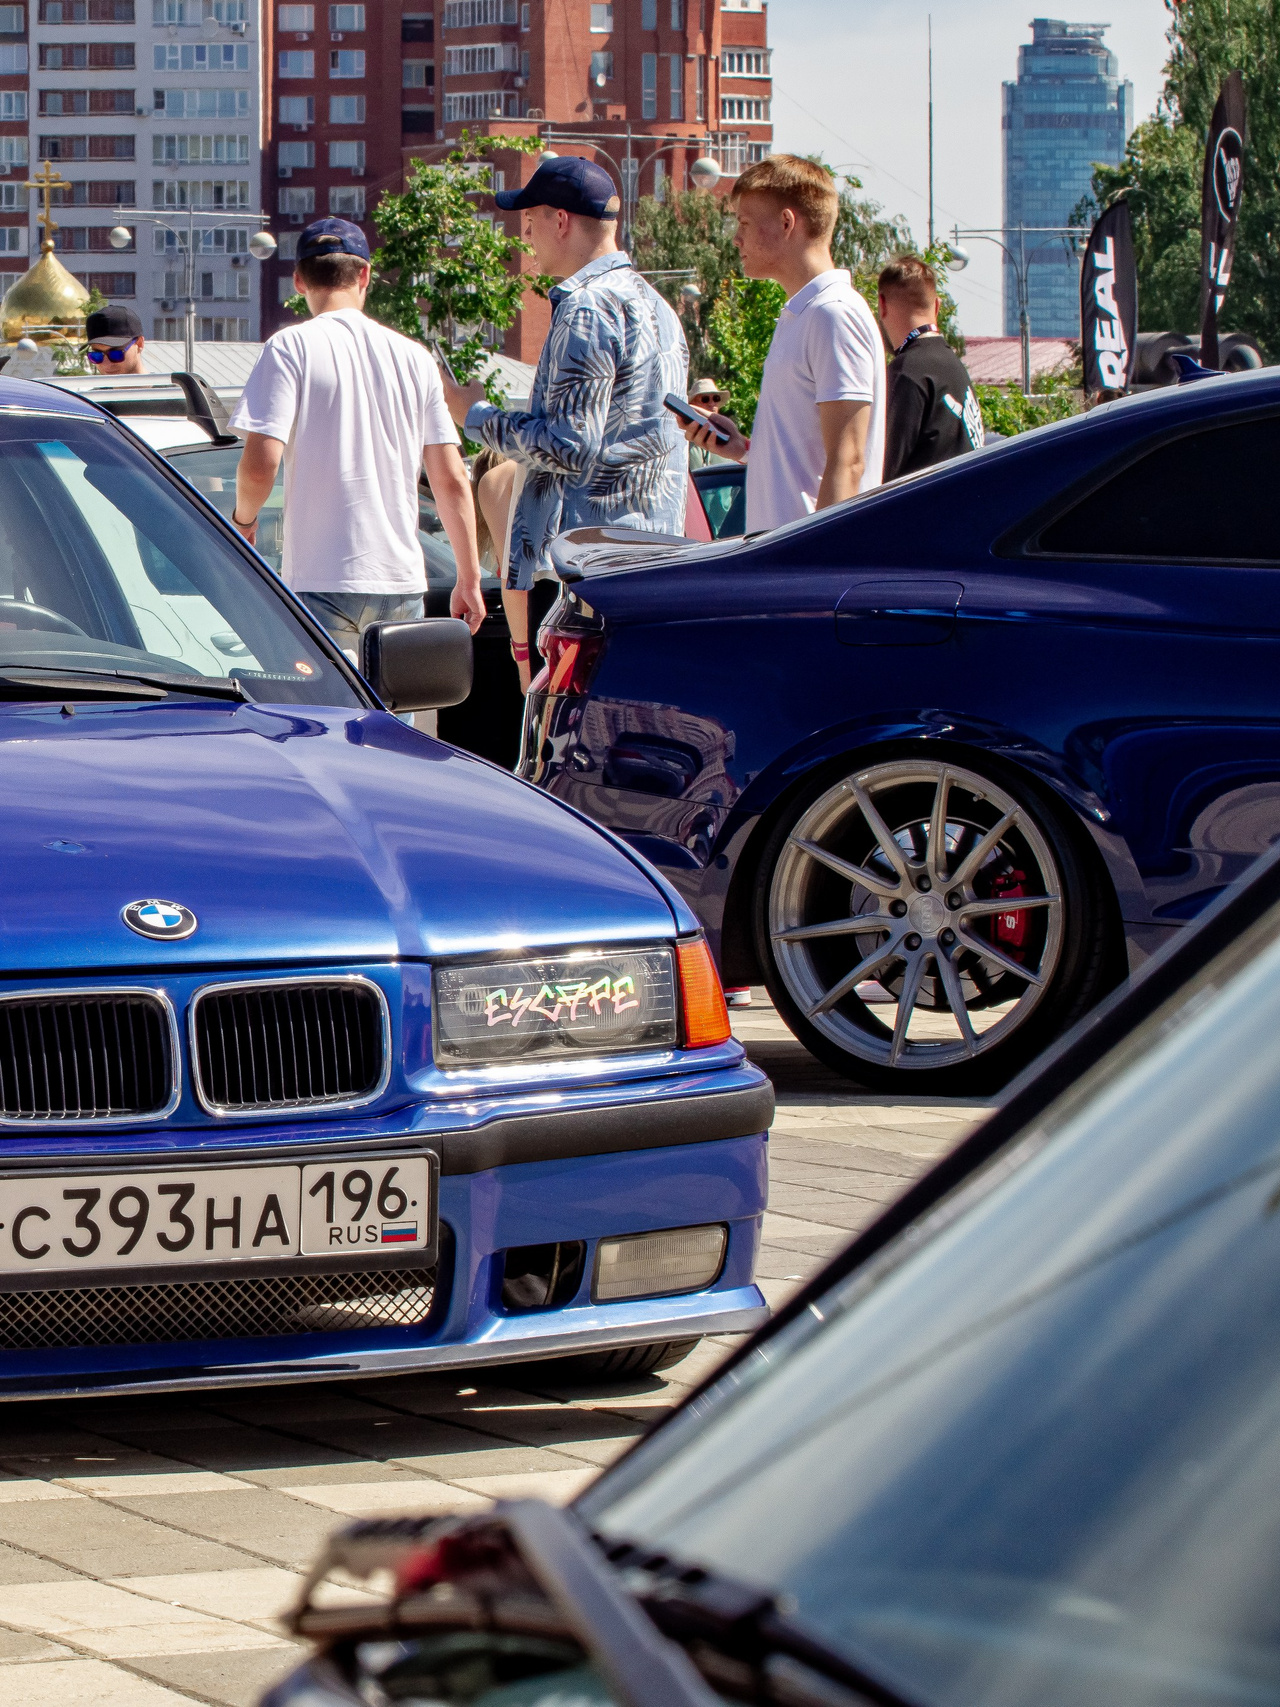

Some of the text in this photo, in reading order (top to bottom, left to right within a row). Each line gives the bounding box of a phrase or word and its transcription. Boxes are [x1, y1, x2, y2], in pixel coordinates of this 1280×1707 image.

[1092, 236, 1128, 389] REAL
[128, 900, 184, 911] BMW
[484, 975, 639, 1027] ESCAPE
[307, 1166, 408, 1224] 196
[329, 1224, 379, 1246] RUS
